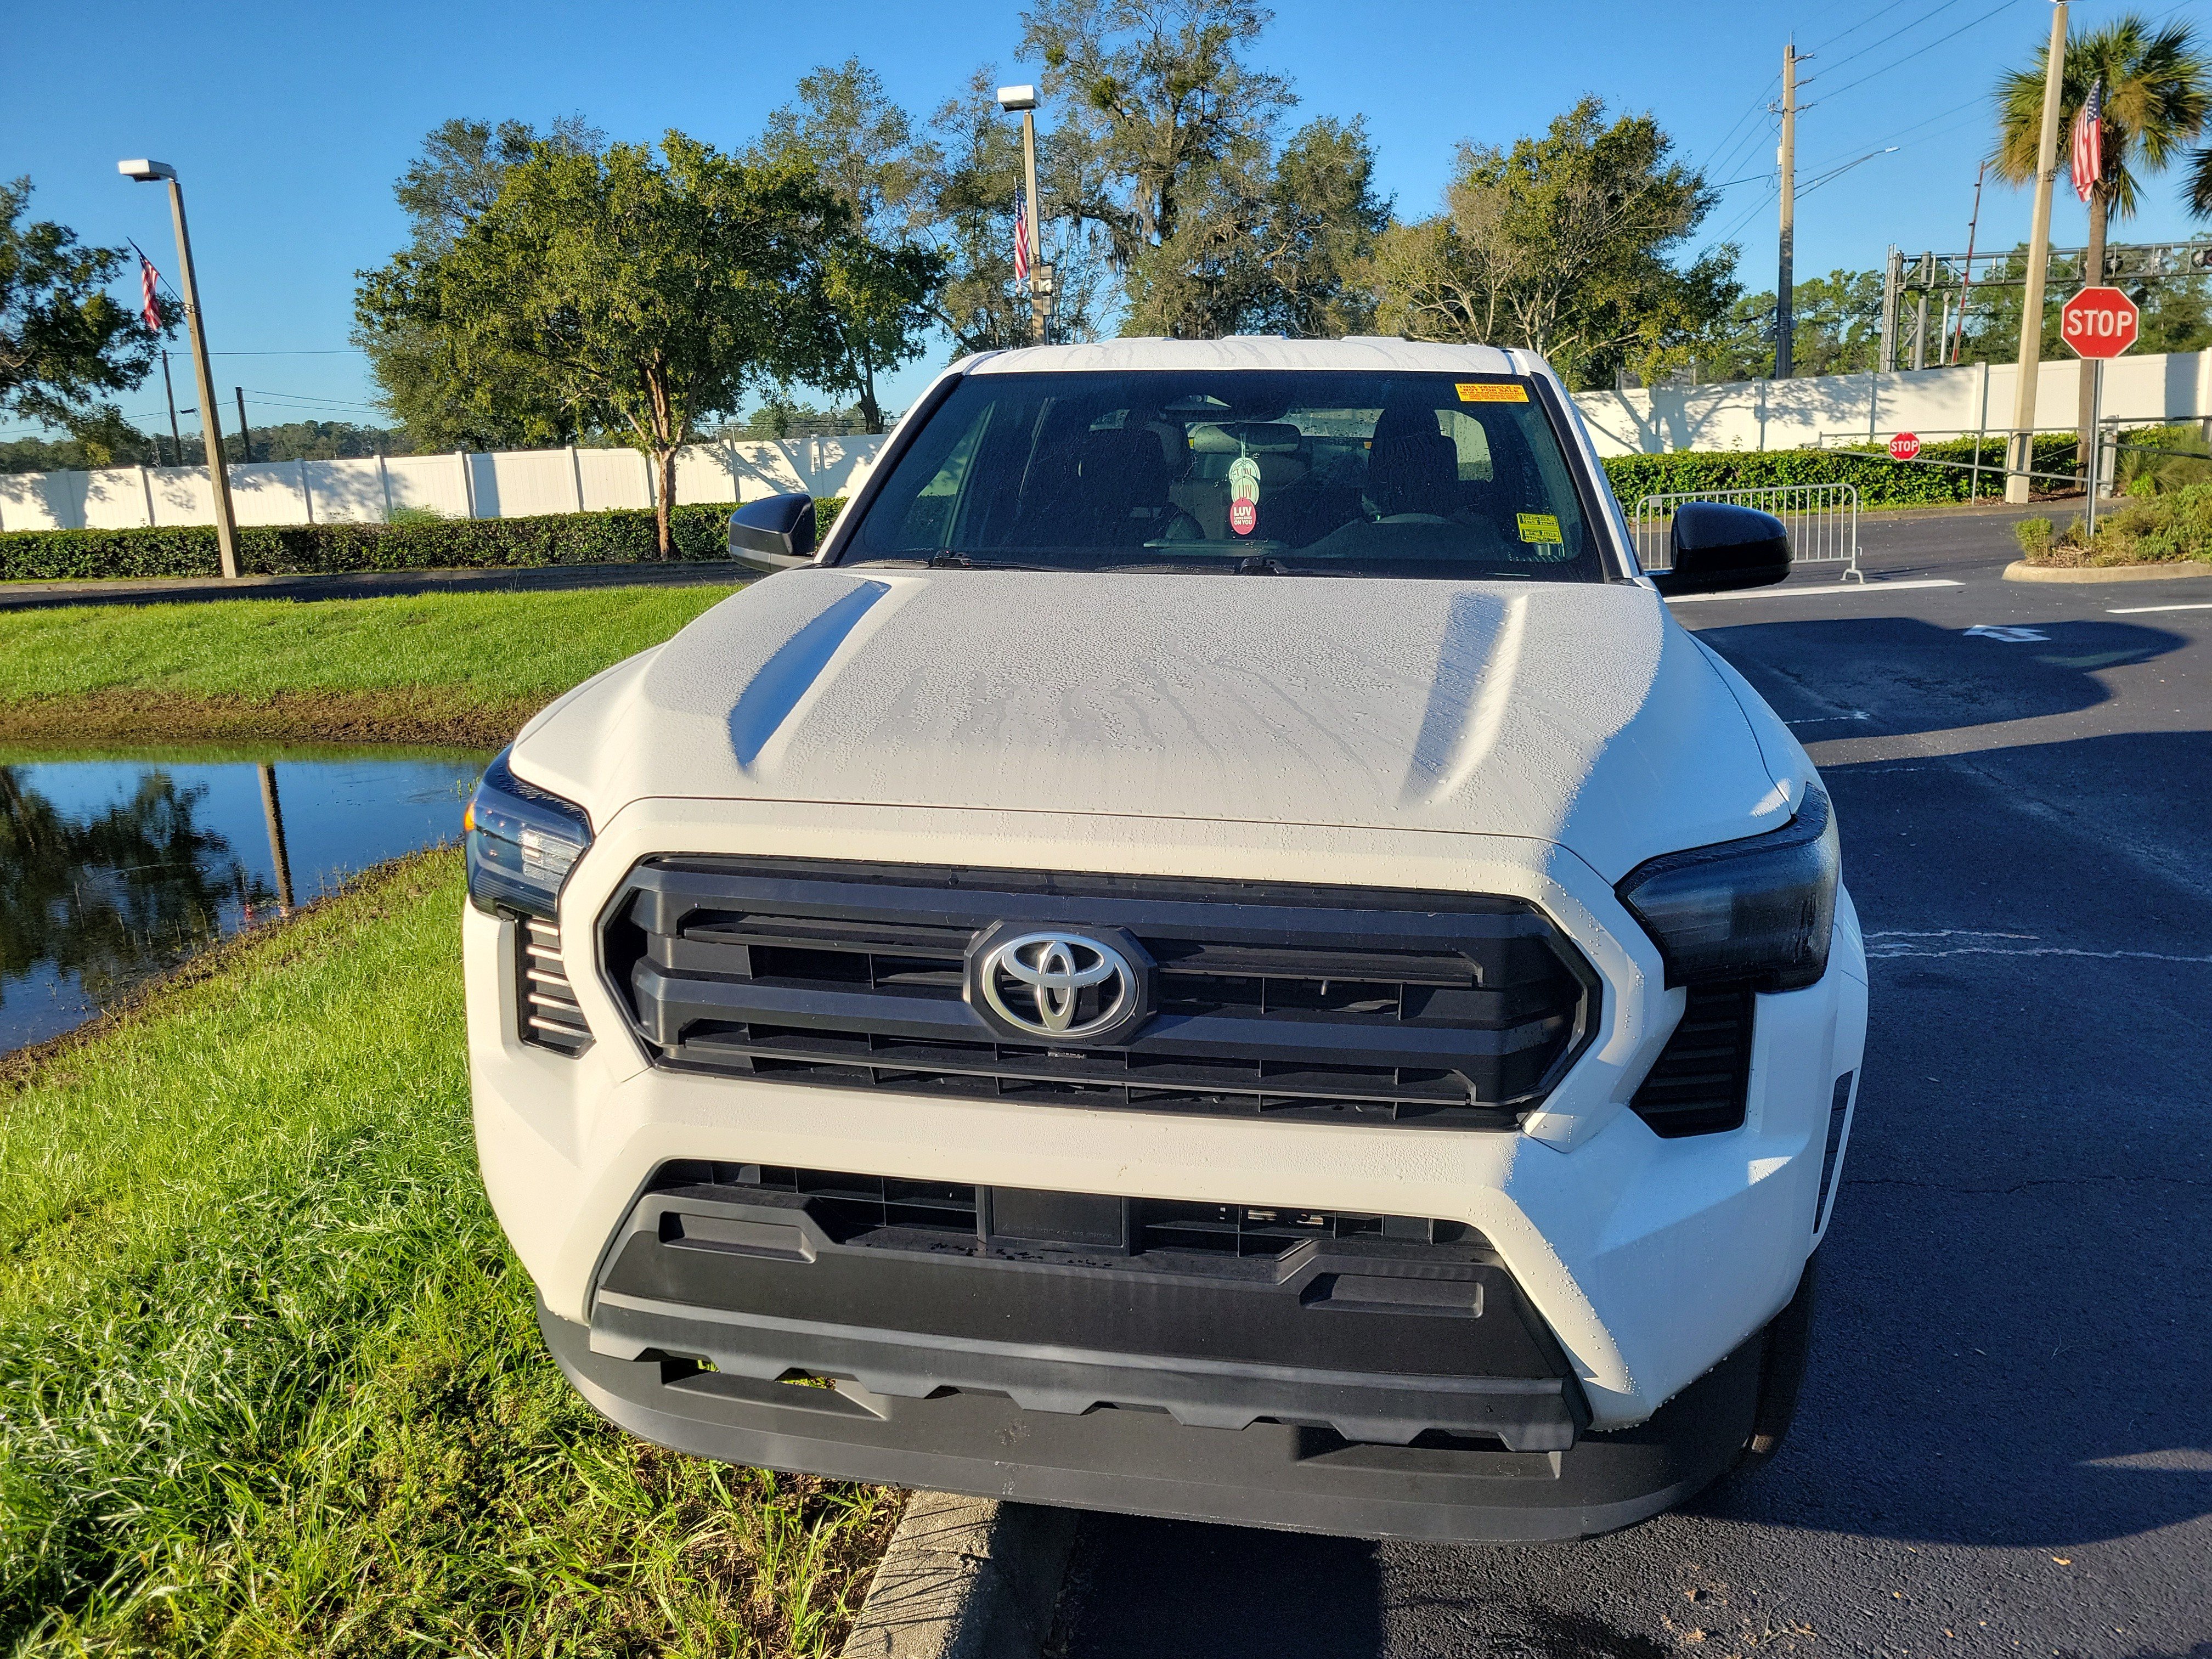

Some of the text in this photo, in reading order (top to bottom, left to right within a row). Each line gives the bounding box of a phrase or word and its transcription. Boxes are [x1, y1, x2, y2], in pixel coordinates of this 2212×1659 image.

[2067, 309, 2133, 337] STOP
[1891, 440, 1918, 453] STOP
[1234, 506, 1252, 516] LUV
